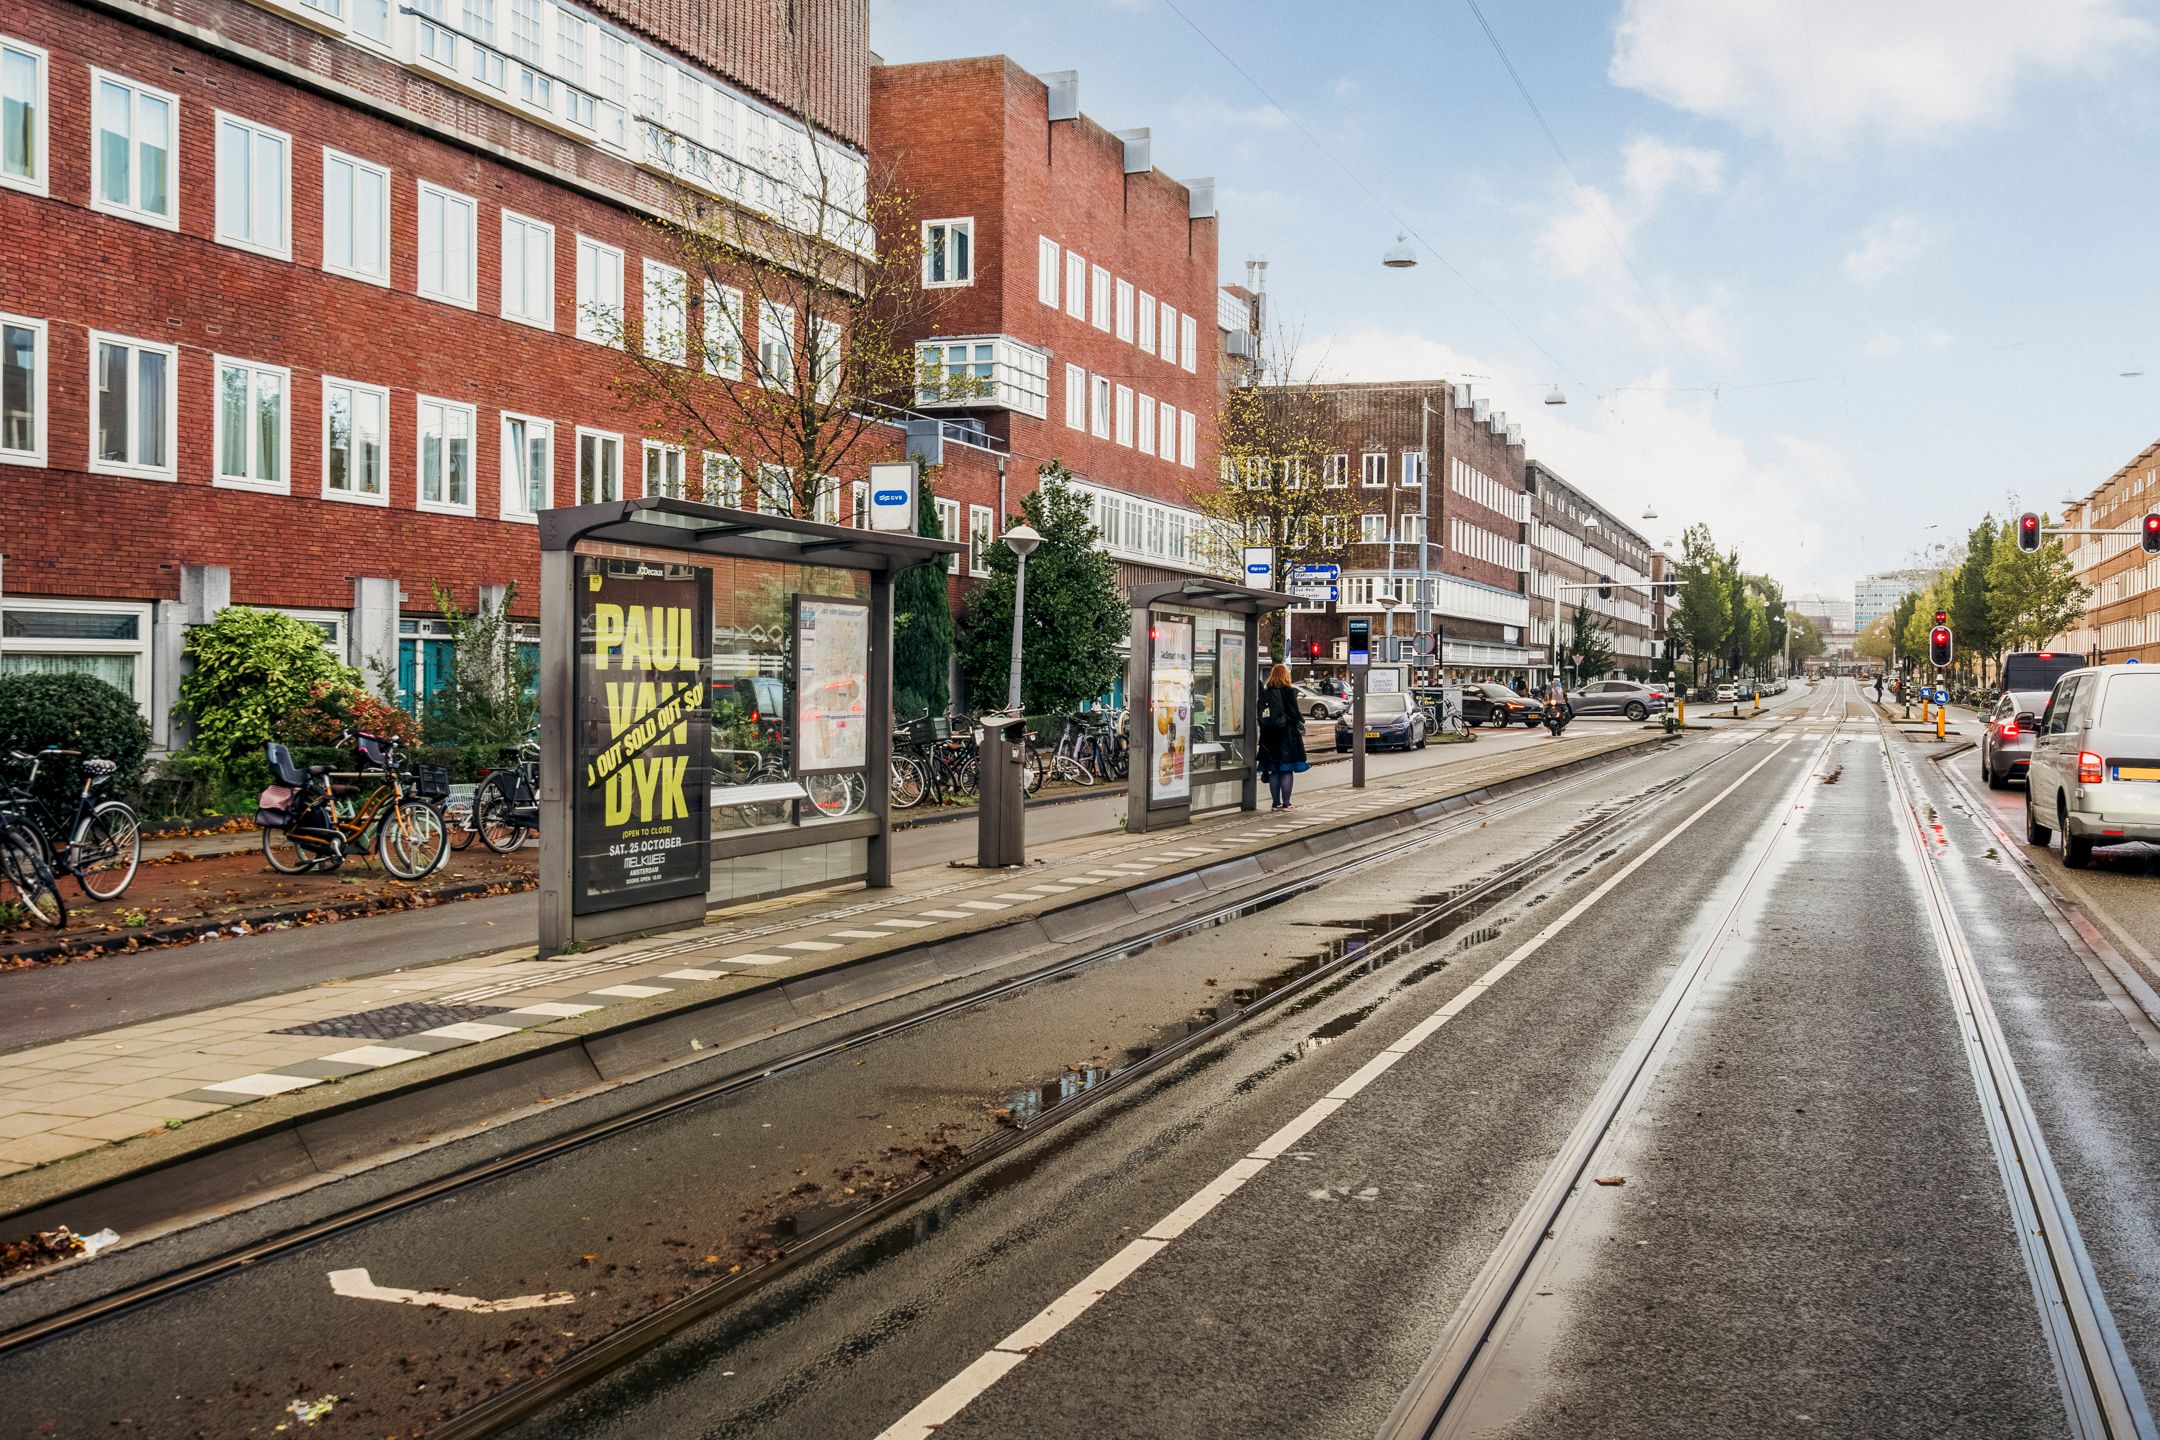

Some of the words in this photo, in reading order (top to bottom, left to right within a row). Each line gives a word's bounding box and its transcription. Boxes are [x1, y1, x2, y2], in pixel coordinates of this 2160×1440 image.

[636, 566, 663, 577] JCDecaux
[595, 603, 699, 671] PAUL
[605, 682, 688, 745] VAN
[597, 740, 622, 778] OUT
[623, 717, 657, 757] SOLD
[657, 696, 682, 731] OUT
[605, 755, 690, 827] DYK
[609, 844, 628, 857] SAT.
[629, 842, 640, 854] 25
[641, 837, 682, 851] OCTOBER
[622, 829, 640, 840] (OPEN
[651, 826, 672, 835] CLOSE)
[630, 866, 659, 876] AMSTERDAM
